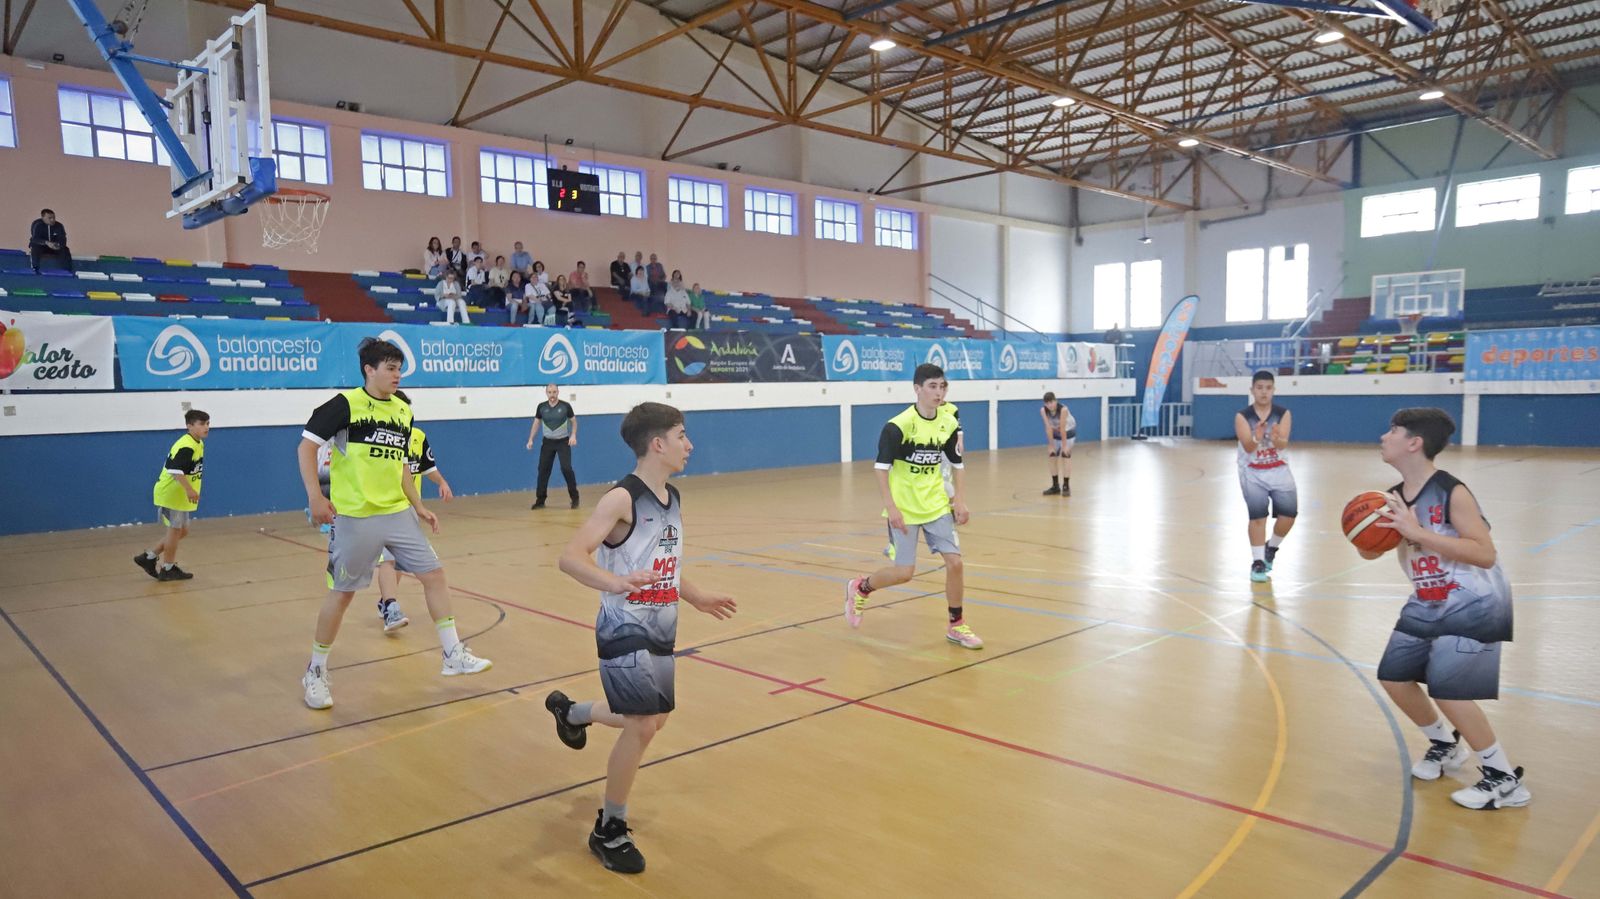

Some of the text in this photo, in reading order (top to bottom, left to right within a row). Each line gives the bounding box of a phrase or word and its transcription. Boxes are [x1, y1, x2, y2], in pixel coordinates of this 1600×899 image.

[560, 188, 578, 200] 2 3
[557, 200, 562, 208] 1
[217, 334, 322, 354] baloncesto
[421, 338, 503, 357] baloncesto
[583, 340, 649, 359] baloncesto
[1481, 344, 1599, 368] deportes
[33, 359, 97, 380] cesto
[369, 447, 403, 461] DKV
